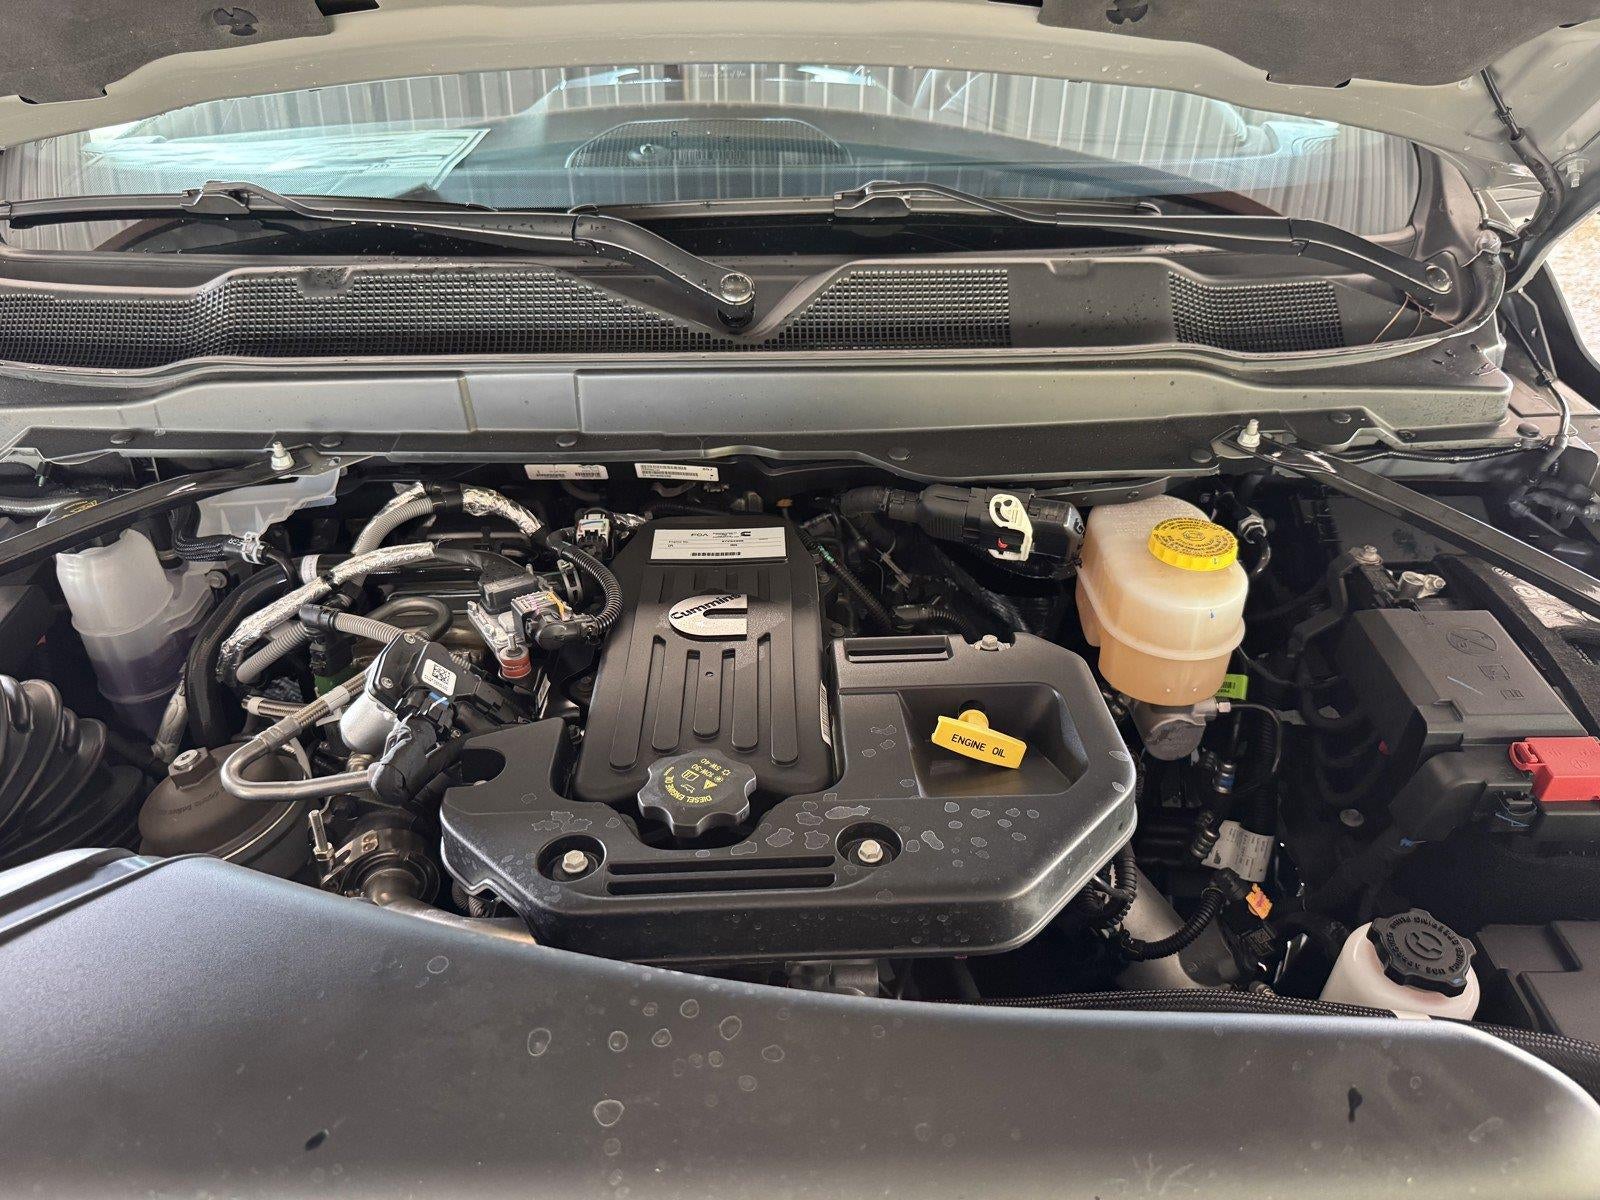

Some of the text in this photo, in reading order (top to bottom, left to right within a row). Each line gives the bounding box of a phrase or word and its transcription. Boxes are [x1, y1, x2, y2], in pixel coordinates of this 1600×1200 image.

[951, 733, 1006, 758] ENGINE OIL
[686, 795, 713, 804] DIESEL
